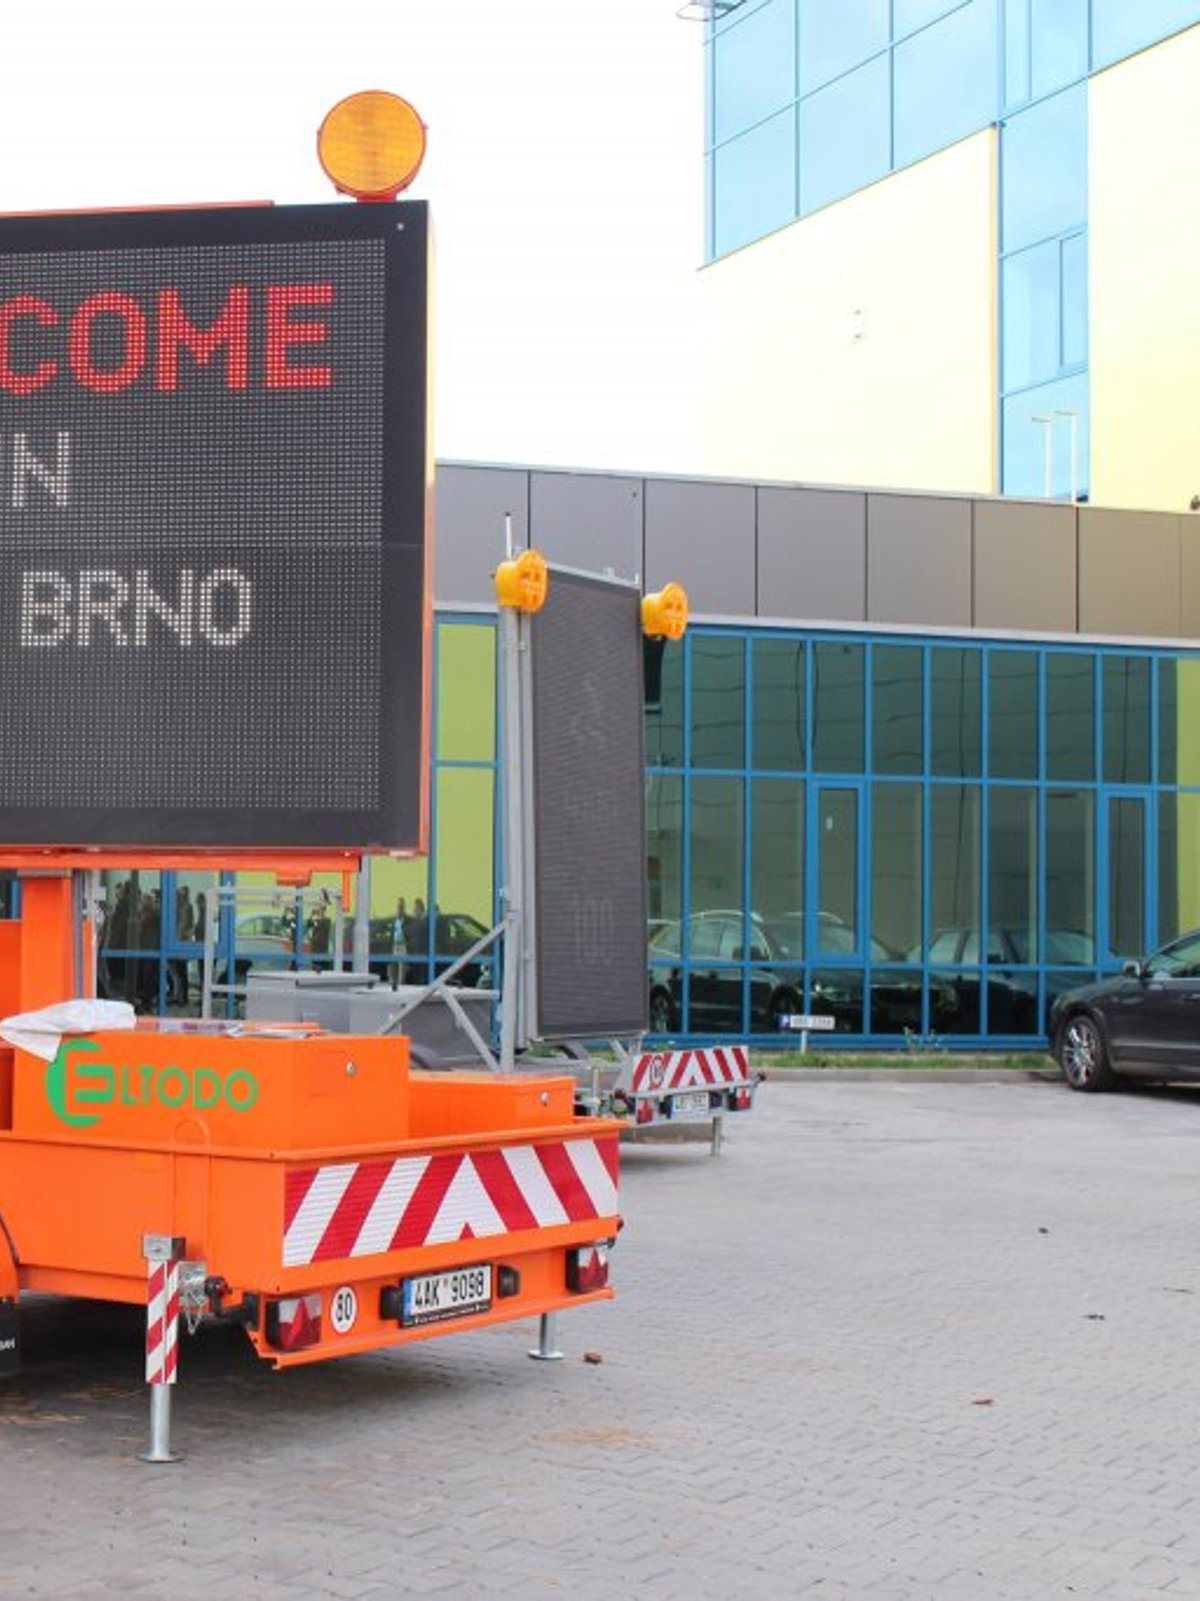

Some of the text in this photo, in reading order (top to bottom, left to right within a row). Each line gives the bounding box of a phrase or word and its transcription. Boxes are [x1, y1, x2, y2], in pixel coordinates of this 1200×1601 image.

[20, 568, 252, 648] BRNO
[46, 1038, 259, 1127] ELTODO
[414, 1279, 440, 1307] 4AK
